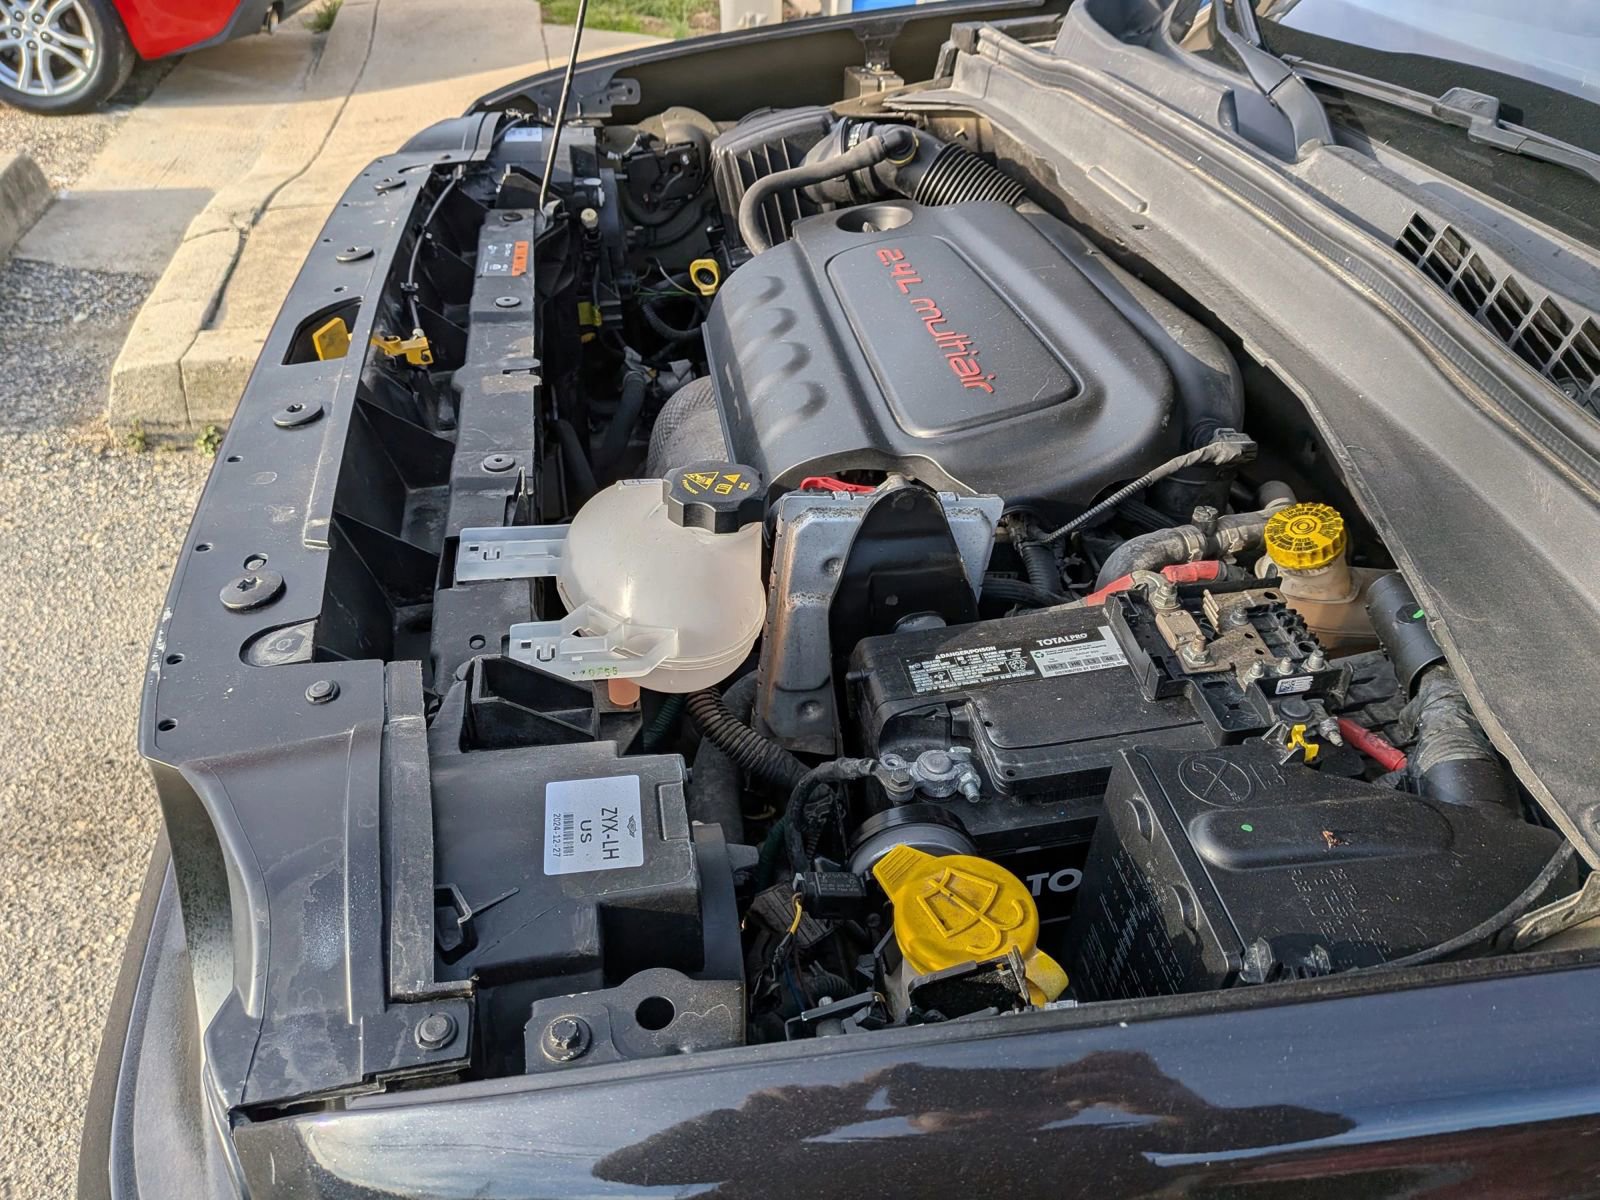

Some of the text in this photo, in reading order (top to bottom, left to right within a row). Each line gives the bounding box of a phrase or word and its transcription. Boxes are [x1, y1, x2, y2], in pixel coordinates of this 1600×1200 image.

[910, 297, 996, 394] multiair
[939, 646, 997, 658] DANGER/POISON
[1036, 633, 1088, 647] TOTALPRO
[552, 813, 561, 858] 2024-12-27
[580, 819, 592, 843] US
[601, 807, 620, 860] ZYX-LH
